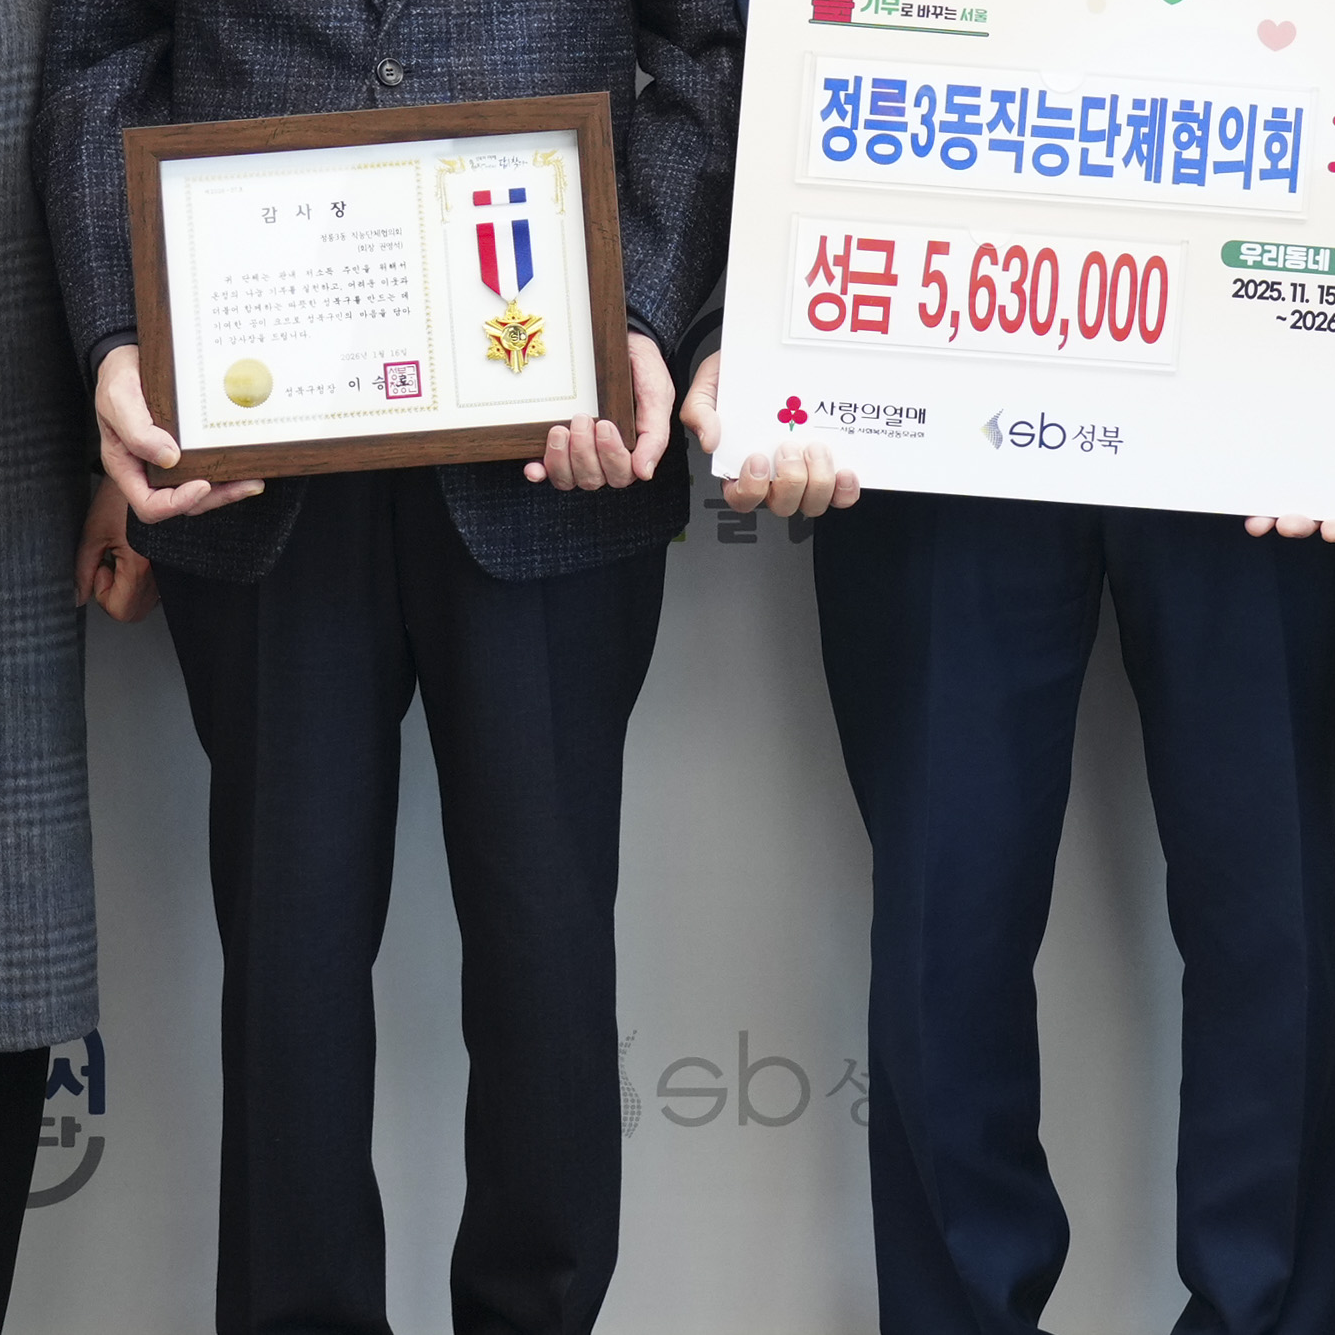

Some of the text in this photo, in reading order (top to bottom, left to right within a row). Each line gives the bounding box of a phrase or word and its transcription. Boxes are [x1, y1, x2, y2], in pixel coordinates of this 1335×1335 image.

[917, 4, 957, 21] 바꾸는
[960, 7, 988, 23] 서울
[820, 75, 1304, 193] 정릉3동직능단체협의회
[1239, 243, 1330, 272] 우리동네
[805, 234, 1168, 351] 성금 5,630,000
[814, 401, 926, 428] 사랑의열매
[1009, 412, 1124, 455] sb 성북
[656, 1029, 811, 1127] sb
